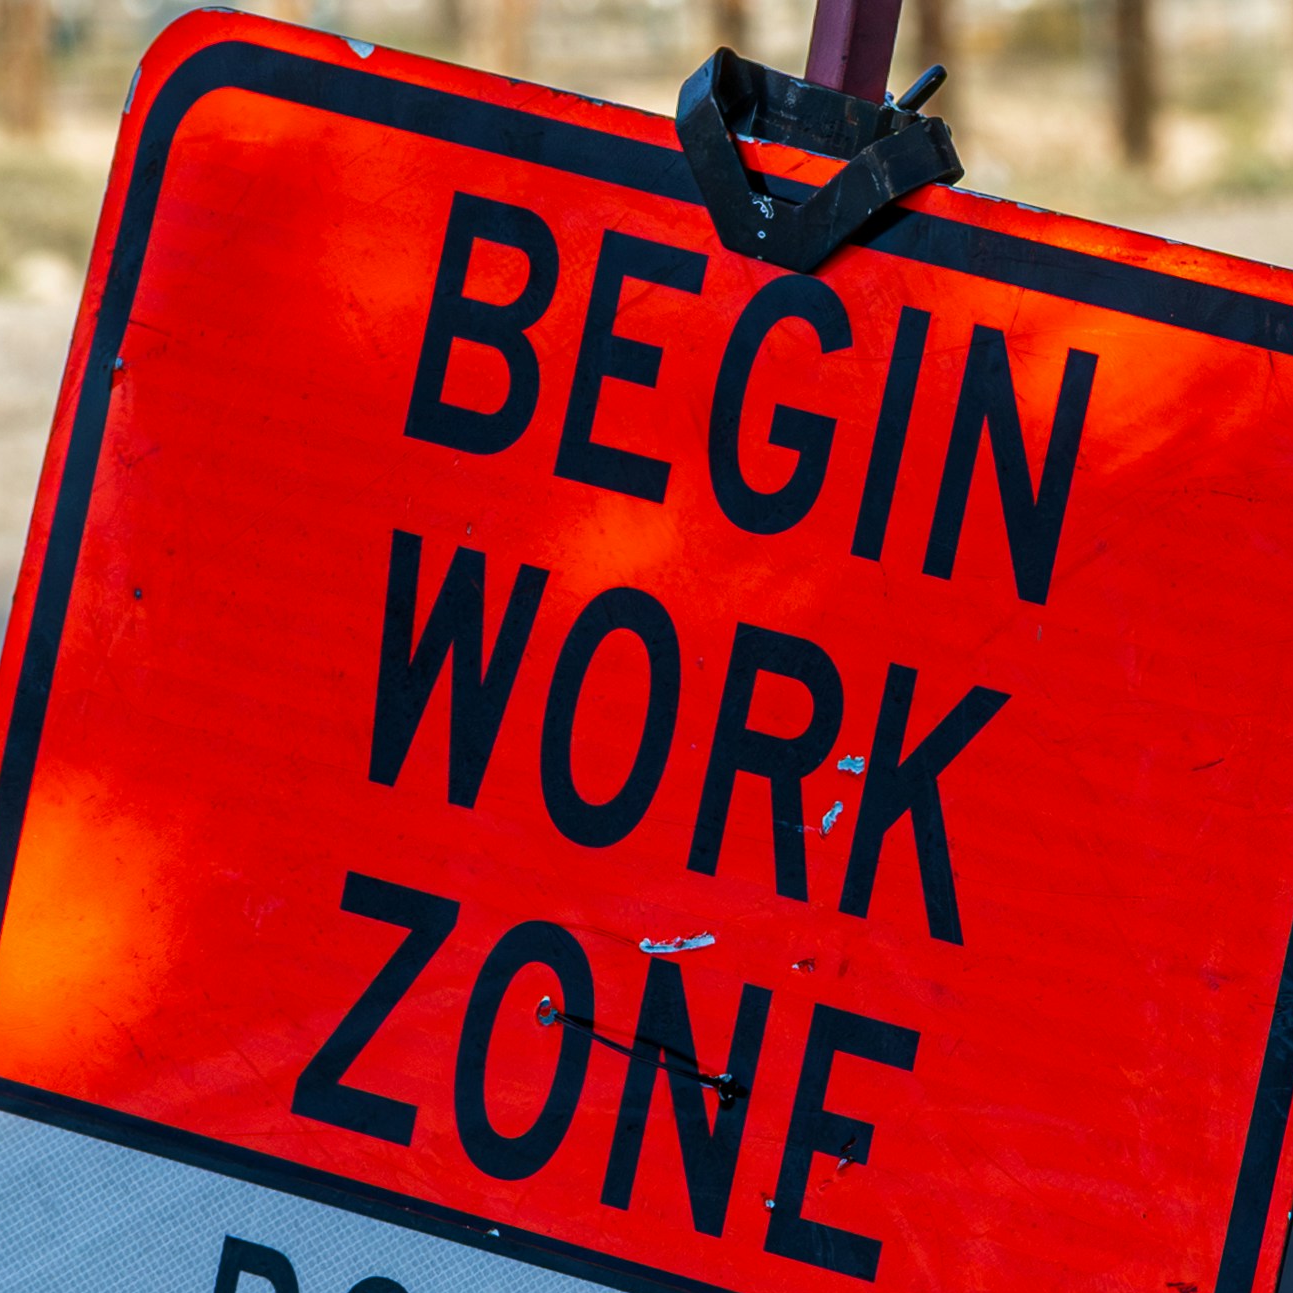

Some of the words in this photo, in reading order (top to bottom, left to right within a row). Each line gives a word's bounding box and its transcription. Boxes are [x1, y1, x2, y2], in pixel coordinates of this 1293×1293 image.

[404, 191, 1099, 606] BEGIN
[368, 529, 1011, 946] WORK
[291, 871, 921, 1283] ZONE
